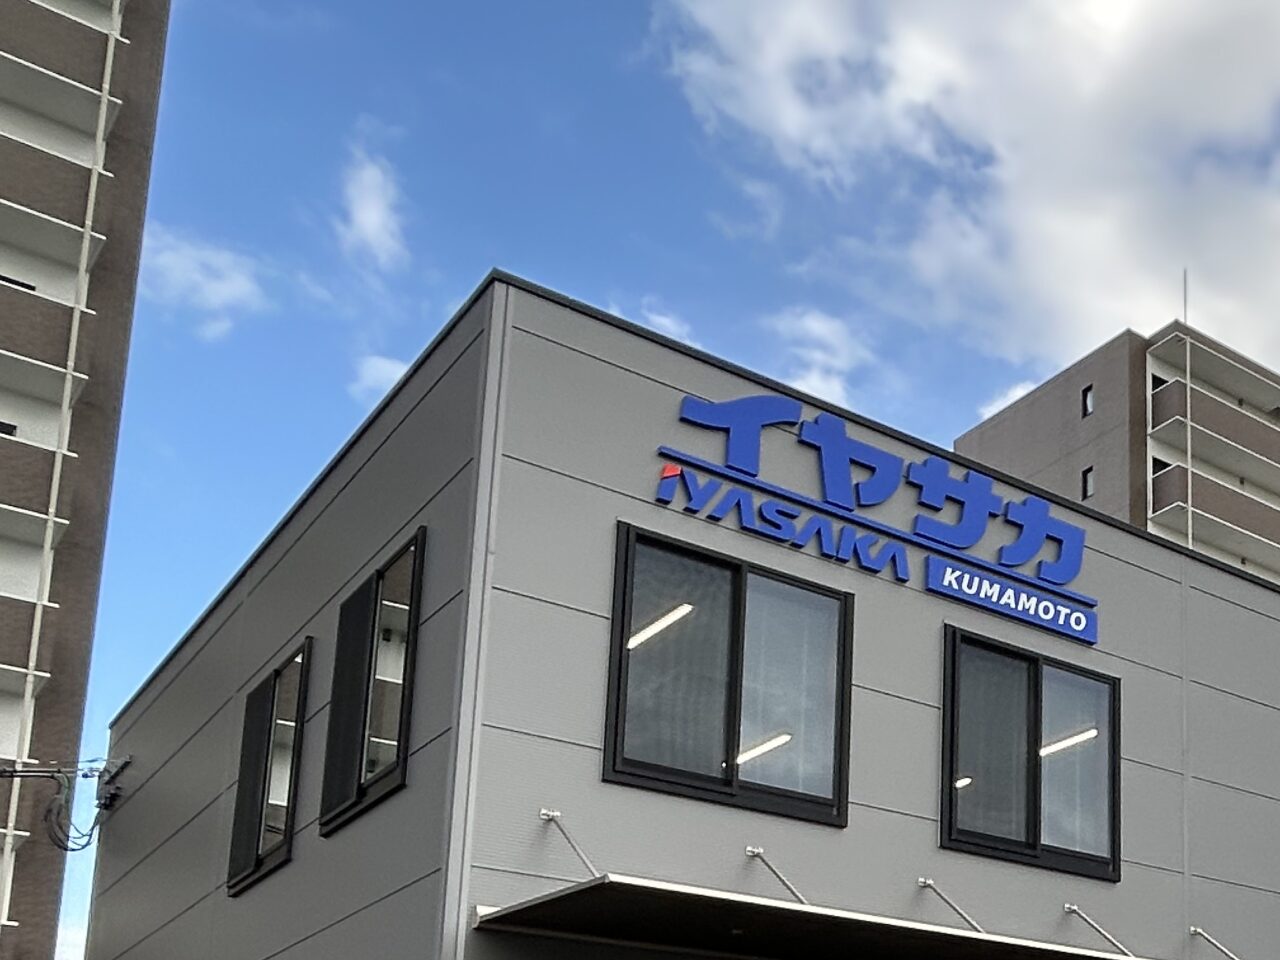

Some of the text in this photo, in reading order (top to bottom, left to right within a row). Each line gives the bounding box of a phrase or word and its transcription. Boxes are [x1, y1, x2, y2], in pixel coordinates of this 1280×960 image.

[656, 463, 909, 583] IYASAKA
[680, 395, 1085, 585] イヤサカ
[942, 567, 1087, 631] KUMAMOTO
